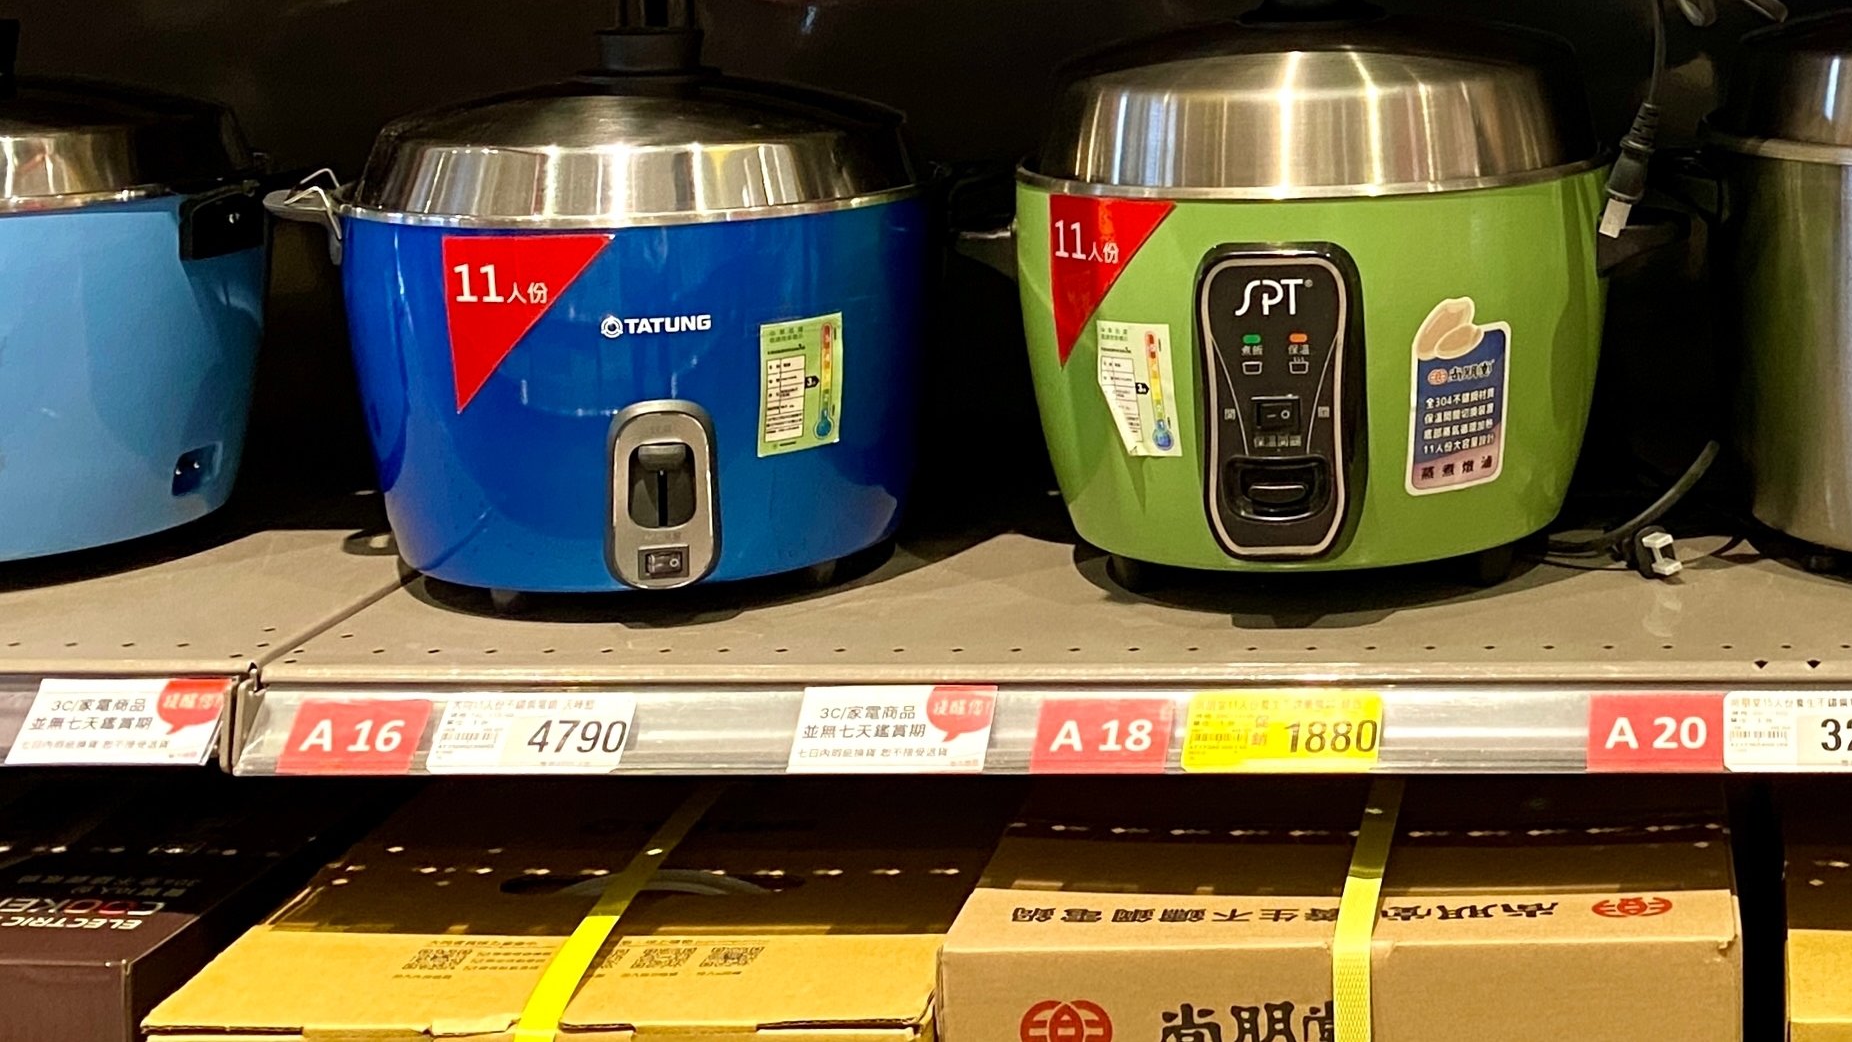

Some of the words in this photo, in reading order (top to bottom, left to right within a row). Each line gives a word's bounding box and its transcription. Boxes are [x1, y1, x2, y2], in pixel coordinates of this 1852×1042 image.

[1054, 220, 1119, 264] 11人份
[453, 264, 548, 304] 11人份
[625, 314, 711, 334] TATUNG
[1288, 345, 1309, 355] 保溫
[820, 706, 916, 720] 3C/家電商品
[299, 720, 332, 752] A
[346, 719, 406, 752] 16
[527, 720, 627, 753] 4790
[802, 724, 926, 738] 並無七天鑑賞期
[1050, 720, 1084, 752] A
[1098, 719, 1154, 752] 18
[1284, 719, 1378, 753] 1880
[1604, 717, 1640, 749] A
[1652, 716, 1707, 749] 20
[2, 916, 142, 930] ELECTRIC
